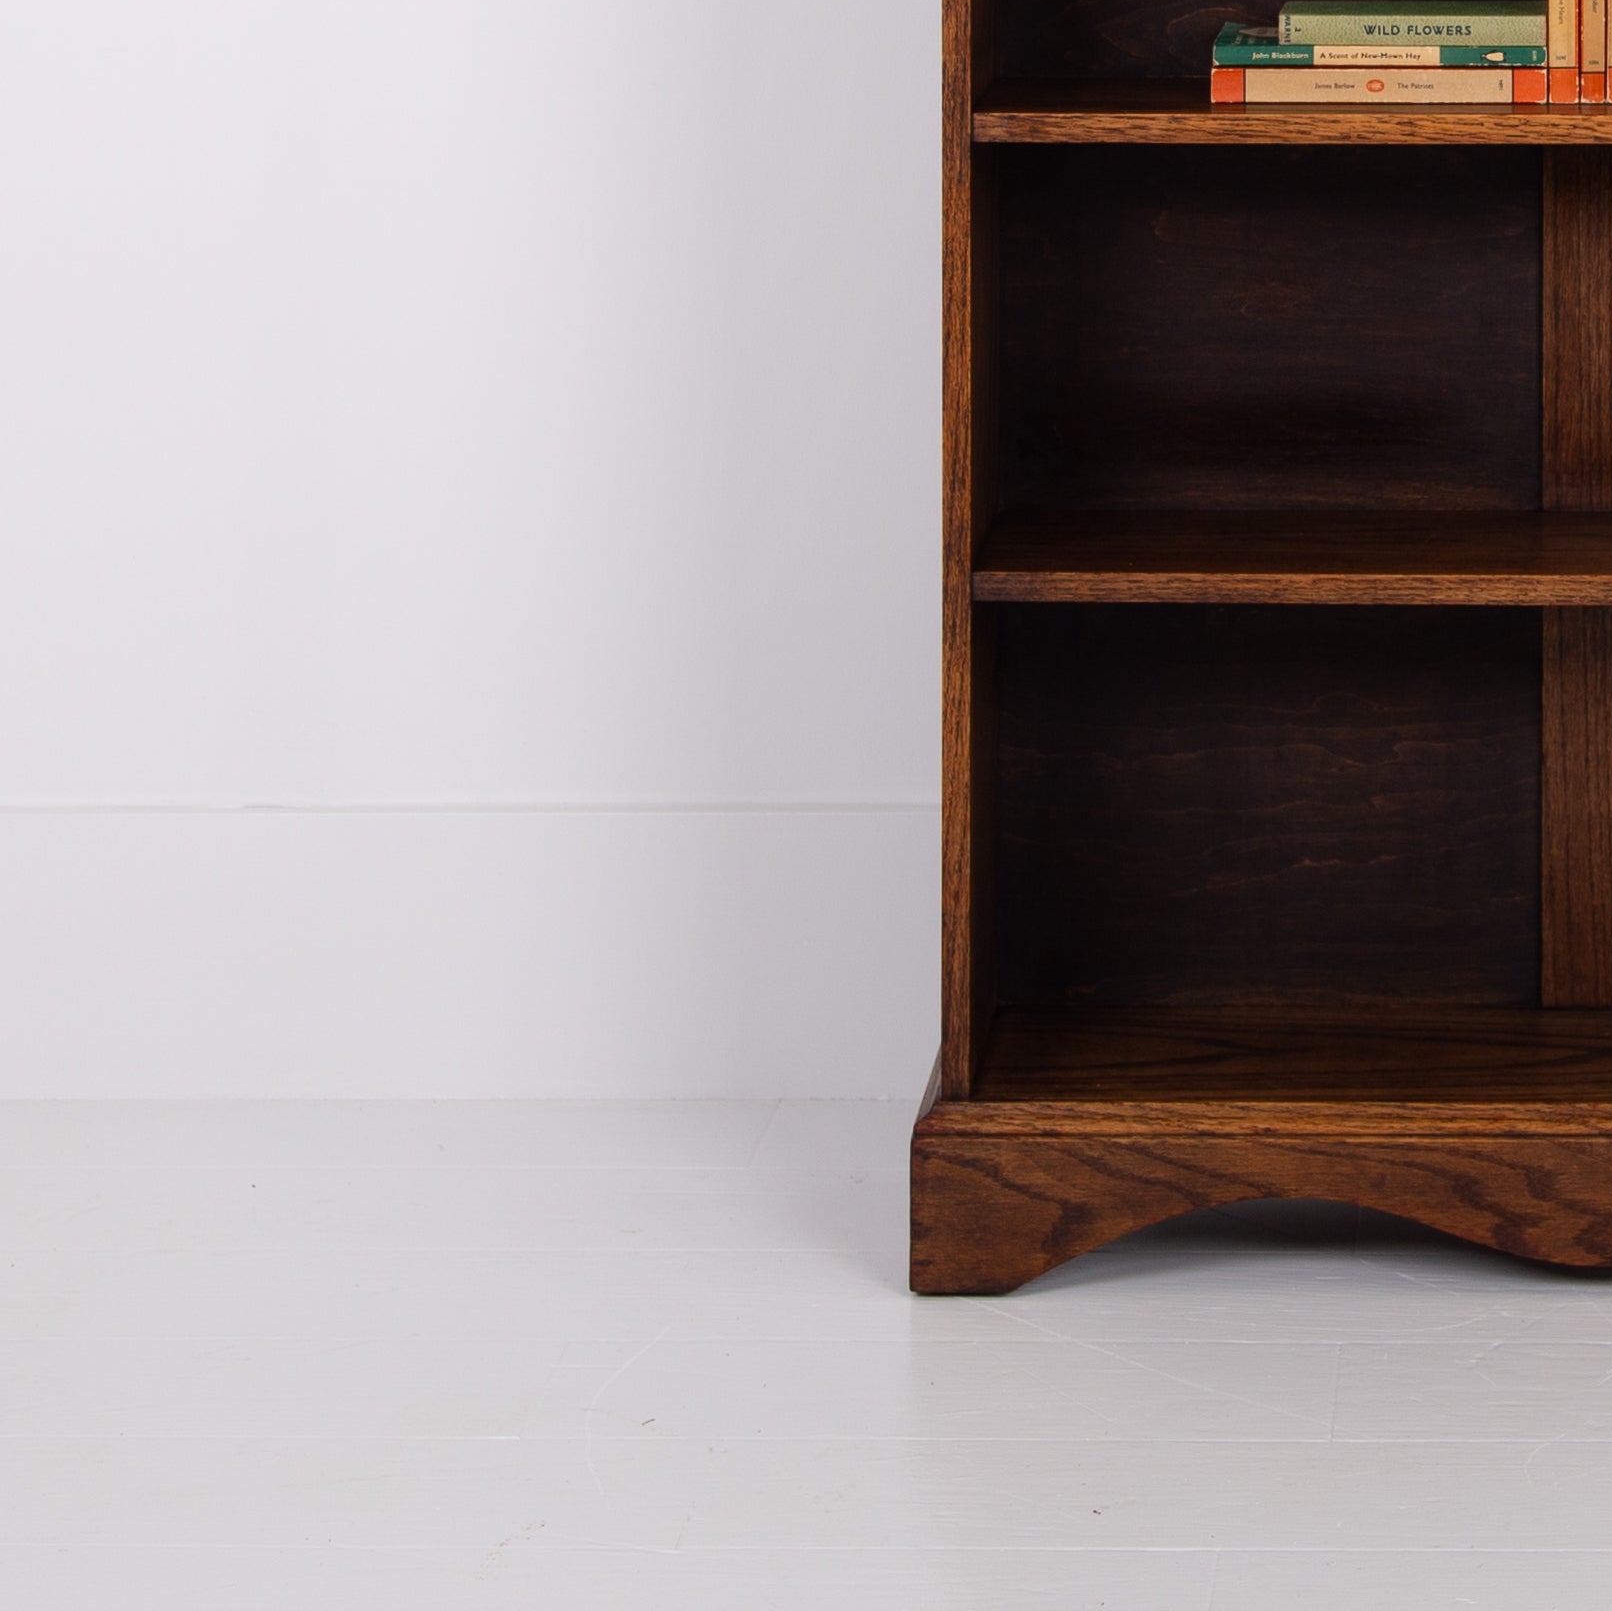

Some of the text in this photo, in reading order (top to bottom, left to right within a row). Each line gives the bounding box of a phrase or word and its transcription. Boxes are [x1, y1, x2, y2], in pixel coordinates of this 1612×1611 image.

[1363, 24, 1472, 36] WILD FLOWERS
[1252, 52, 1270, 60] John
[1405, 52, 1421, 60] Hay
